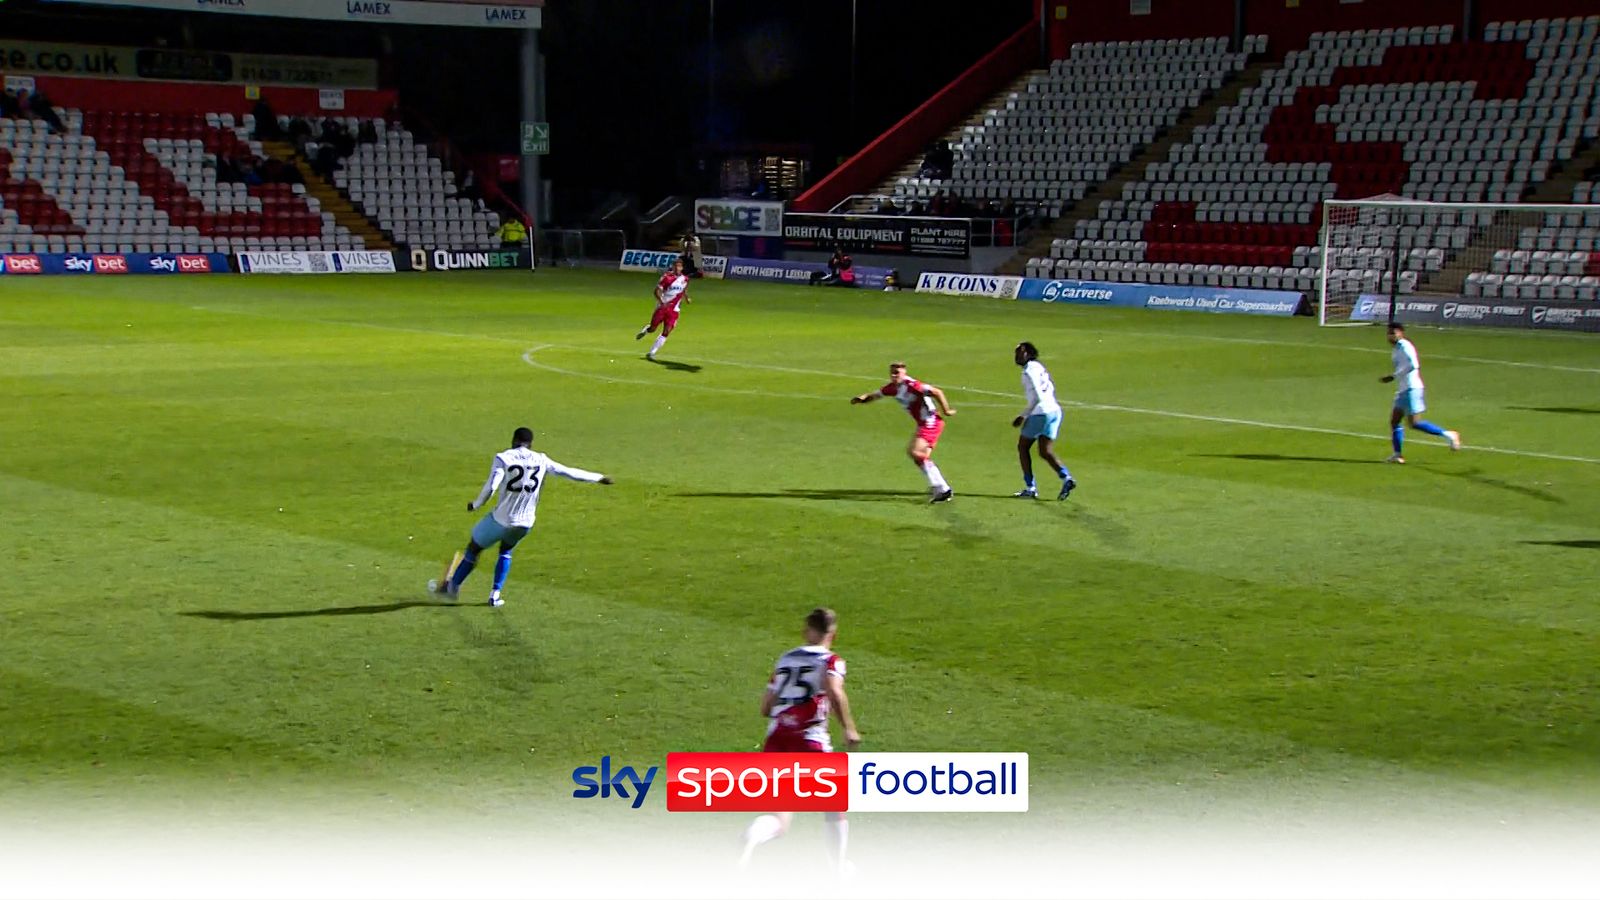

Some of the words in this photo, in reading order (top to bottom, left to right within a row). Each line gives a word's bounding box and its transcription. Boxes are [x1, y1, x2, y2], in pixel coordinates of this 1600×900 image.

[347, 1, 390, 14] LAMEX
[486, 8, 526, 20] LAMEX
[523, 140, 547, 152] Exit
[785, 225, 833, 239] ORBITAL
[837, 227, 904, 242] EQUIPMENT
[911, 227, 942, 236] PLANT
[944, 229, 966, 237] HIRE
[10, 257, 41, 270] bet
[64, 256, 92, 271] sky
[97, 257, 127, 270] bet
[150, 256, 176, 272] sky
[180, 256, 208, 270] bet
[250, 252, 302, 266] VINES
[340, 252, 390, 265] VINES
[731, 265, 759, 276] NORTH
[760, 267, 783, 278] HERTS
[921, 274, 932, 288] K
[936, 276, 947, 289] B
[948, 276, 999, 293] COINS
[1061, 287, 1113, 300] carverse
[1219, 299, 1233, 309] Car
[1236, 299, 1293, 312] Supermarket
[1457, 304, 1490, 314] BRISTOL
[1493, 305, 1525, 315] STREET
[1547, 308, 1583, 317] BRISTOL
[506, 464, 540, 493] 23
[775, 665, 815, 705] 25
